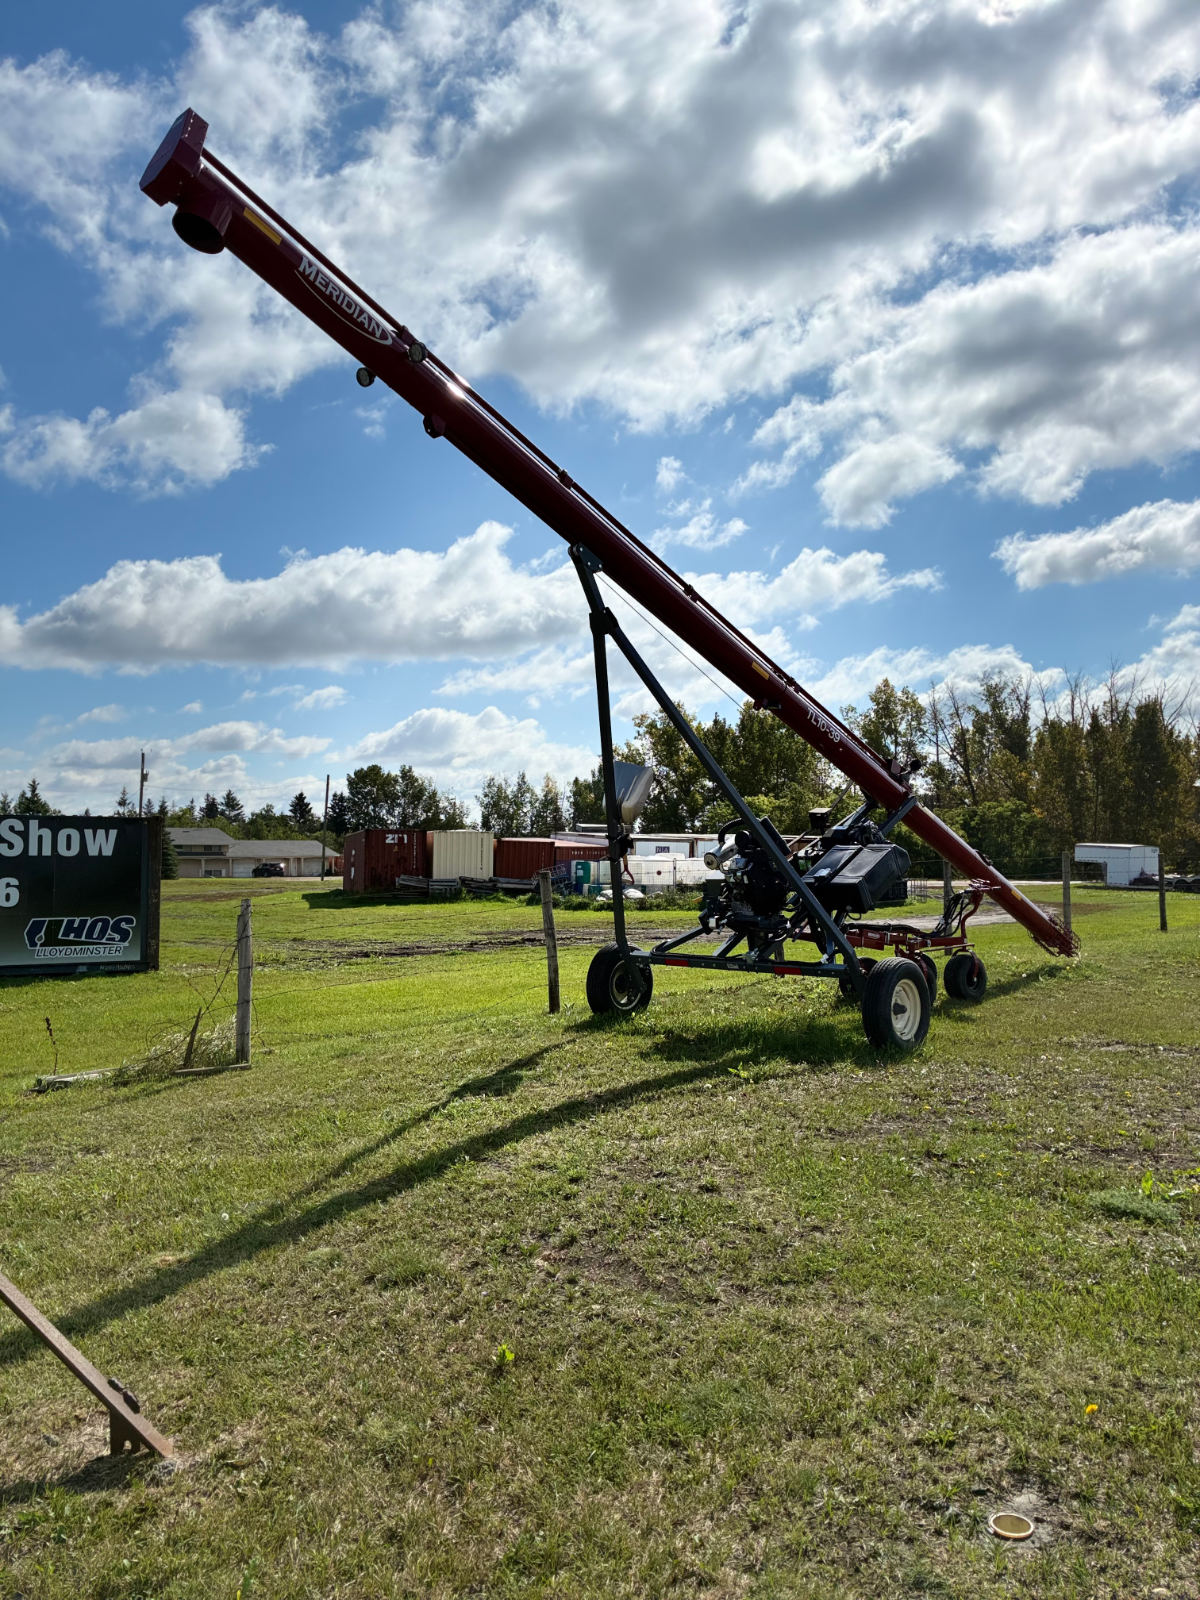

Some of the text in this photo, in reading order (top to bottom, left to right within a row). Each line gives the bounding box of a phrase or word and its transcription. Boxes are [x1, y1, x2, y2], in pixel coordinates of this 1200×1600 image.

[299, 255, 383, 339] MERIDIAN
[807, 707, 841, 743] TL10-39
[0, 818, 118, 857] Show
[0, 877, 20, 908] 6
[35, 945, 123, 958] LLOYDMINSTER
